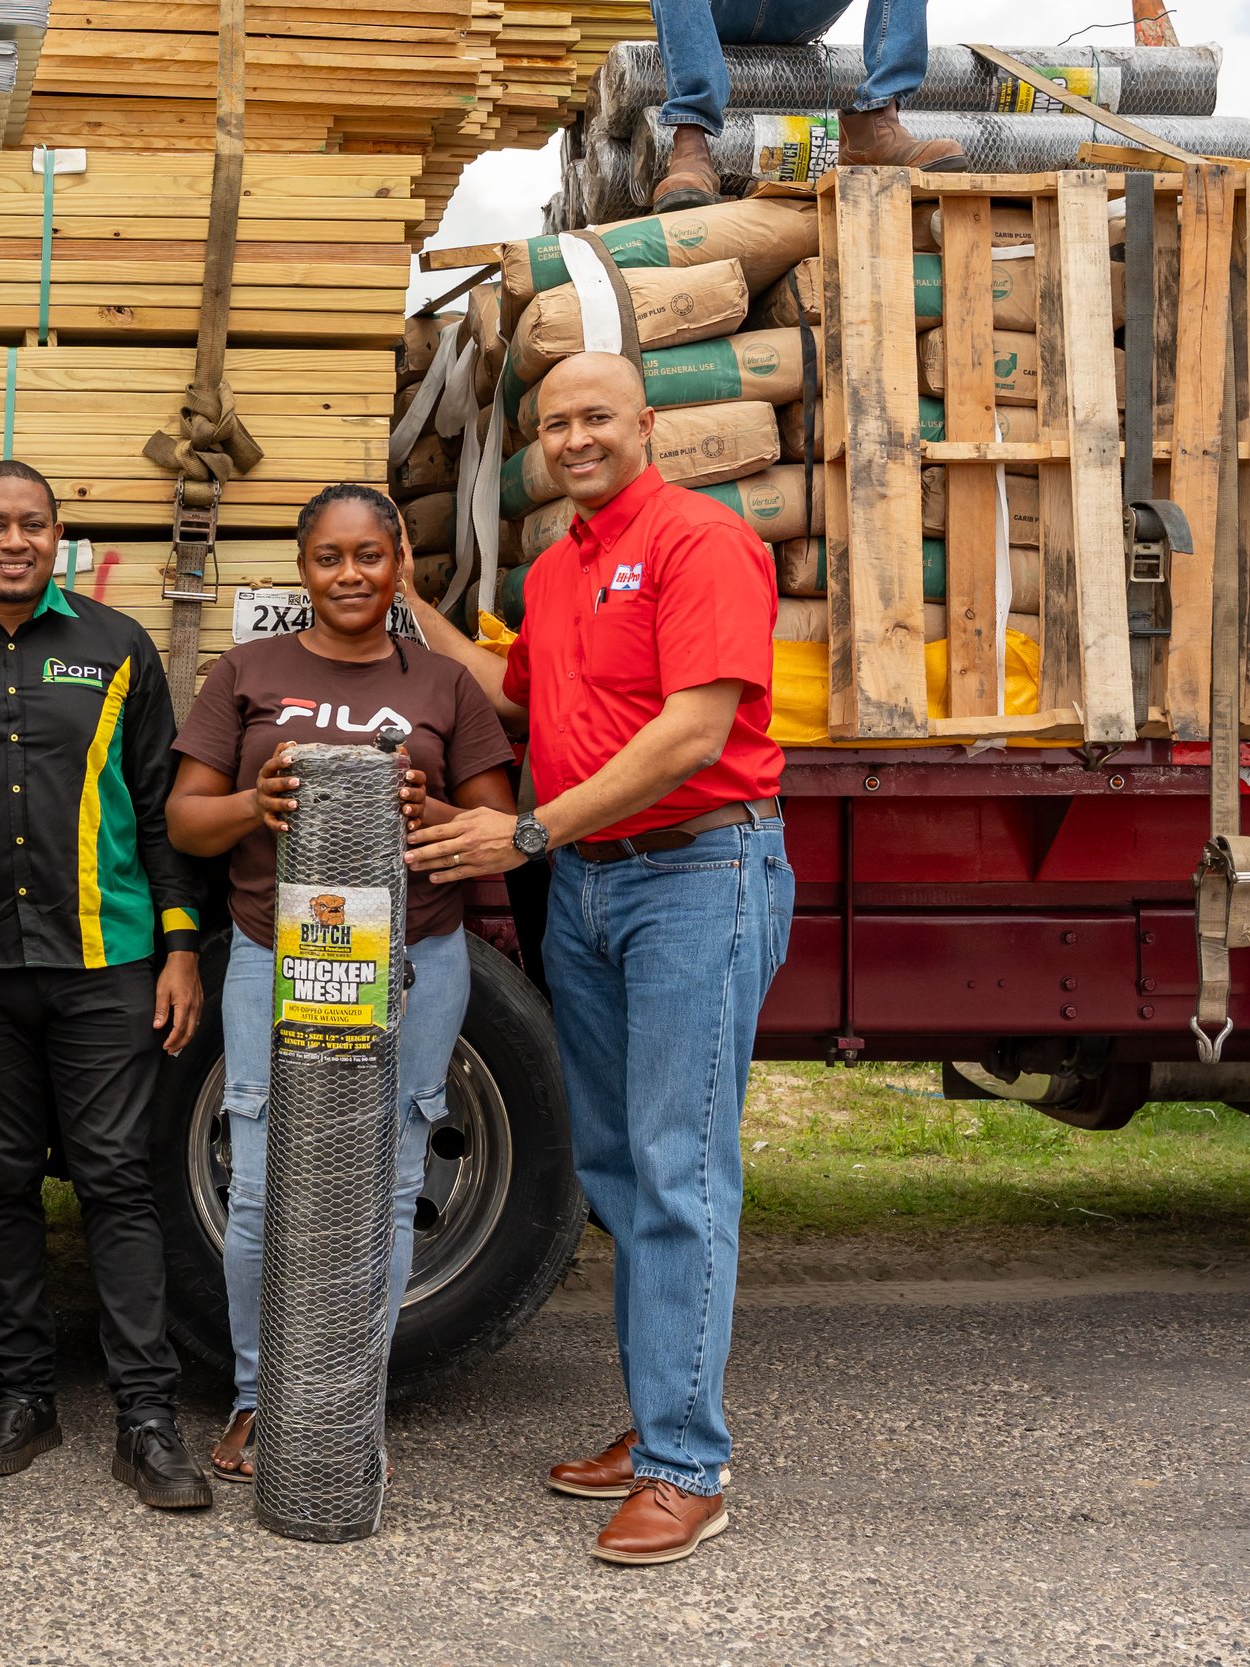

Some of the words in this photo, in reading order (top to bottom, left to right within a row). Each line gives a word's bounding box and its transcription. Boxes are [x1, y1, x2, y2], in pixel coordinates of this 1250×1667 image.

[995, 231, 1014, 239] CARIB
[537, 252, 562, 261] CEME
[637, 312, 648, 321] RIB
[649, 306, 666, 315] PLUS
[643, 360, 659, 368] LUS
[660, 364, 698, 376] GENERAL
[699, 362, 715, 371] USE
[659, 449, 680, 459] CARIB
[680, 447, 697, 456] PLUS
[1013, 514, 1034, 523] CARIB
[53, 664, 103, 681] PQPI
[276, 698, 413, 735] FILA
[301, 923, 351, 945] BUTCH
[283, 957, 375, 982] CHICKEN
[295, 979, 357, 1002] MESH
[289, 1005, 323, 1015] HOT-DIPPED
[324, 1008, 362, 1016] GALVANIZED
[320, 1015, 349, 1023] WEAVING
